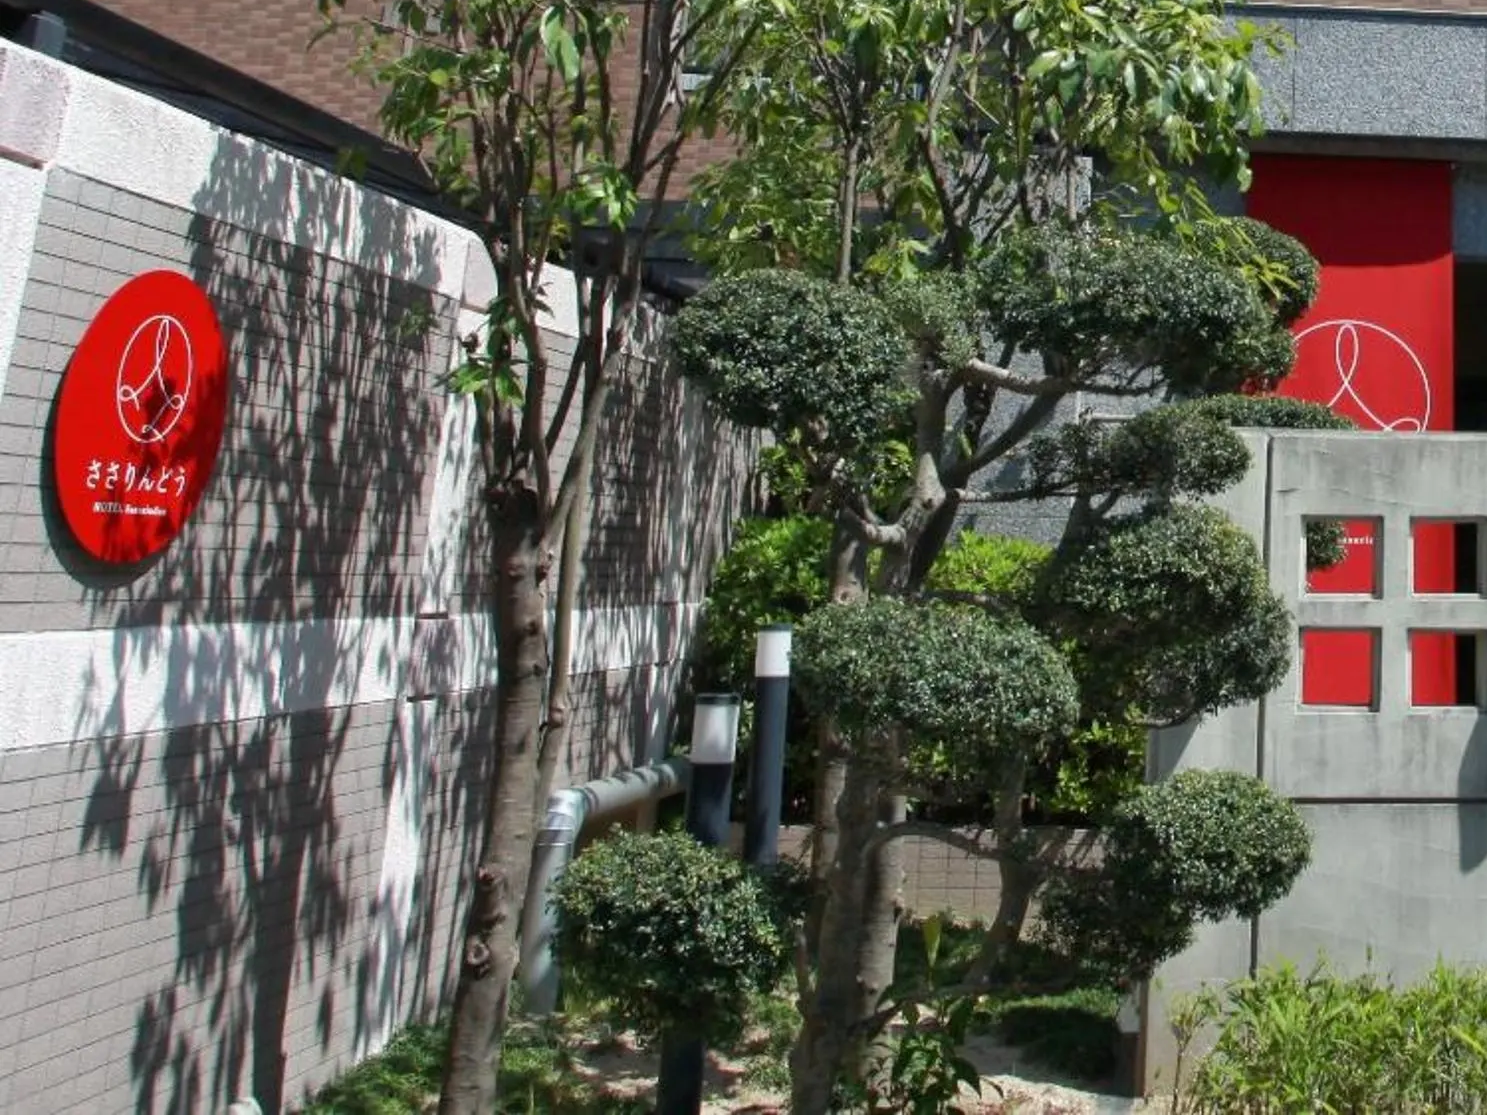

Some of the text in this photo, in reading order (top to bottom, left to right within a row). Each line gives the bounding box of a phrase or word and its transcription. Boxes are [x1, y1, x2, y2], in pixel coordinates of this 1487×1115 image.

[86, 458, 186, 496] ささりんどう
